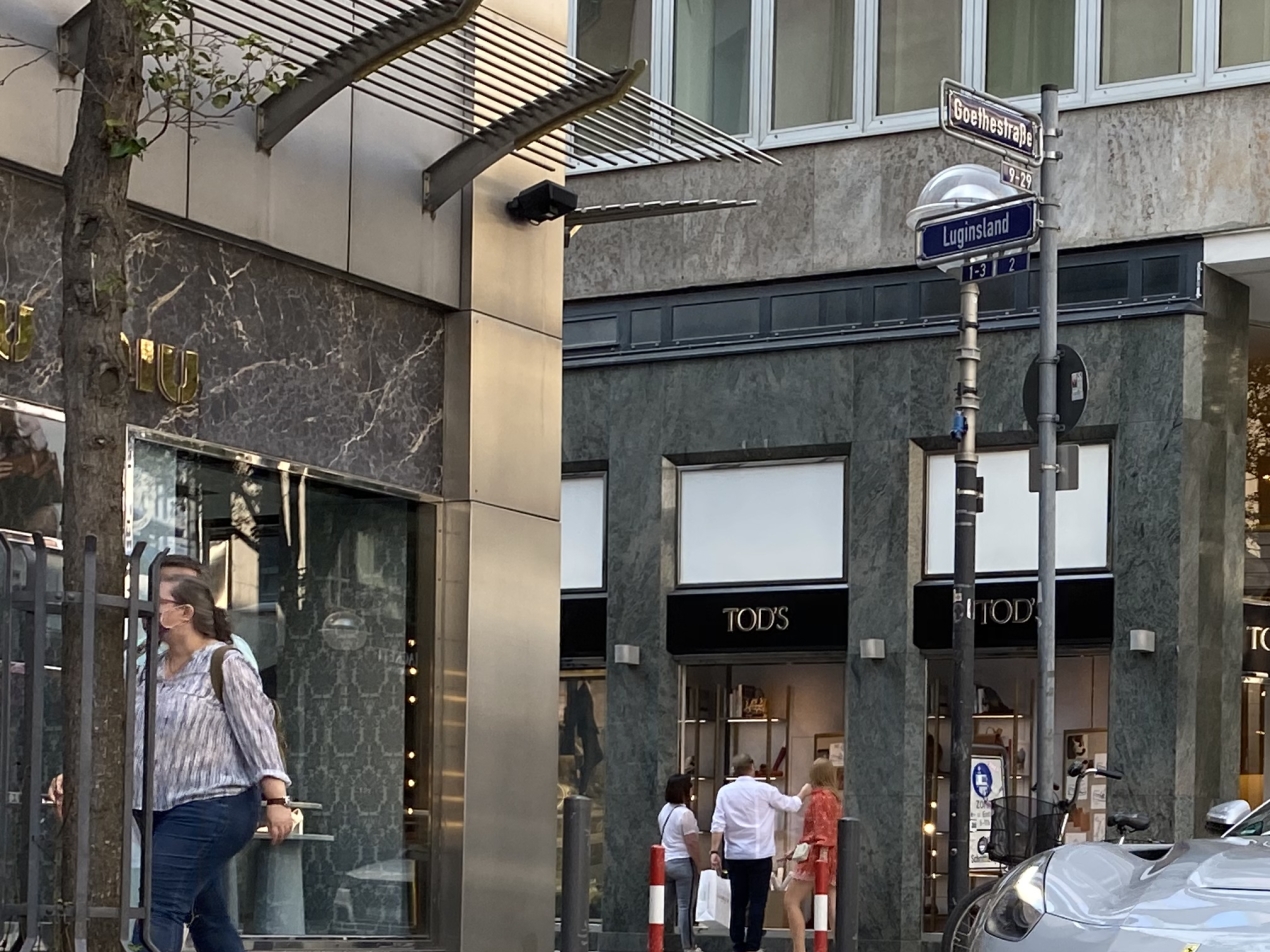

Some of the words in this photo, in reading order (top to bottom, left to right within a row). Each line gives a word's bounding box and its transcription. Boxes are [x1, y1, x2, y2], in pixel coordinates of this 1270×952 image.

[953, 98, 1033, 149] Goethestraße
[1008, 167, 1032, 190] 9-29
[943, 212, 1010, 249] Luginsland
[969, 263, 987, 281] 1-3
[1008, 257, 1015, 273] 2
[722, 606, 789, 632] TOD'S
